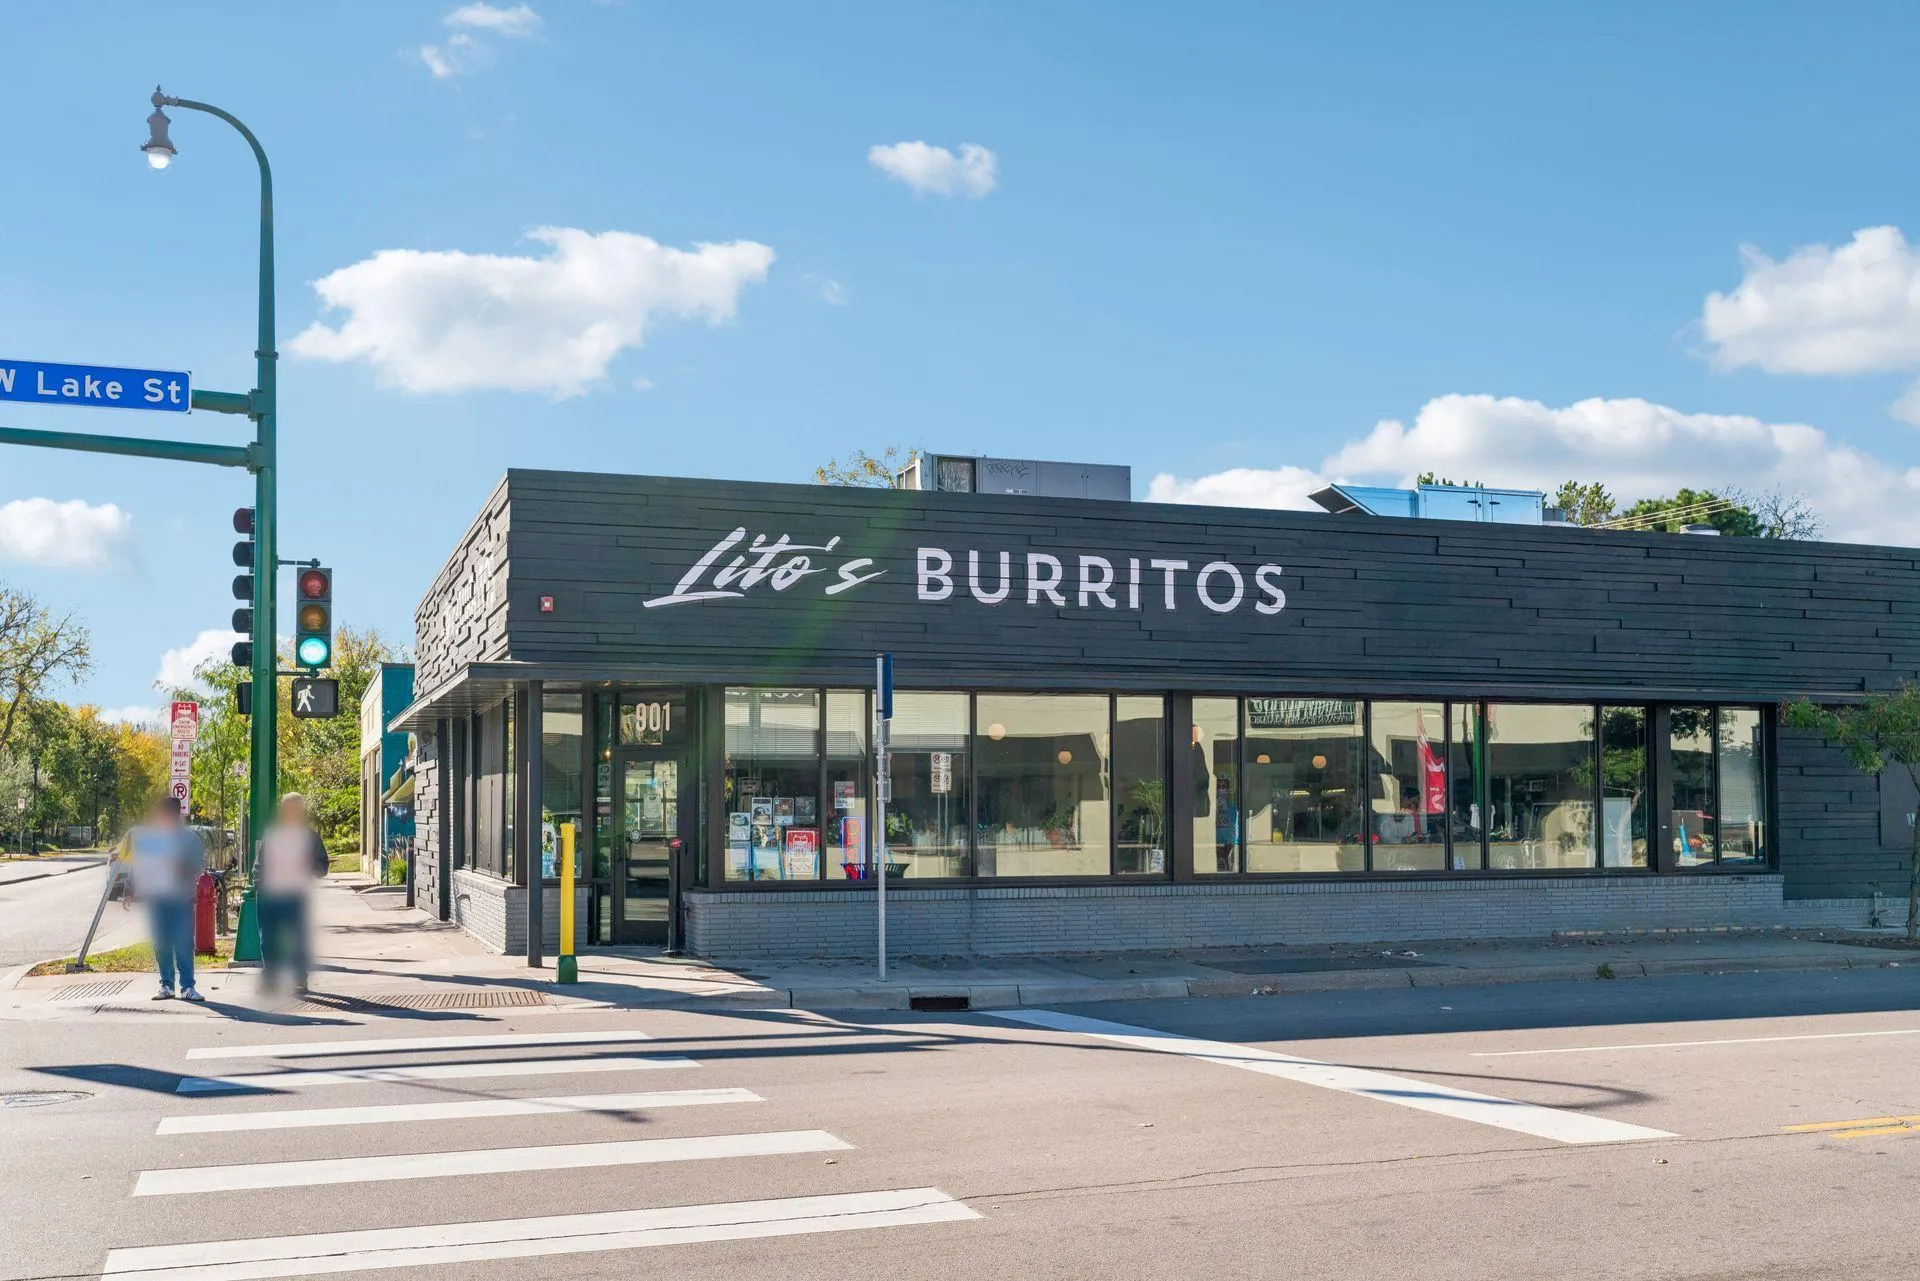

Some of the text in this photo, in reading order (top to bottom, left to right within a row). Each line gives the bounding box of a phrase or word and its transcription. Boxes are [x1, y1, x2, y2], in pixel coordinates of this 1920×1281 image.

[37, 371, 122, 399] Lake
[144, 379, 181, 404] St
[642, 526, 1286, 615] Lito's BURRITOS
[636, 702, 670, 731] 901
